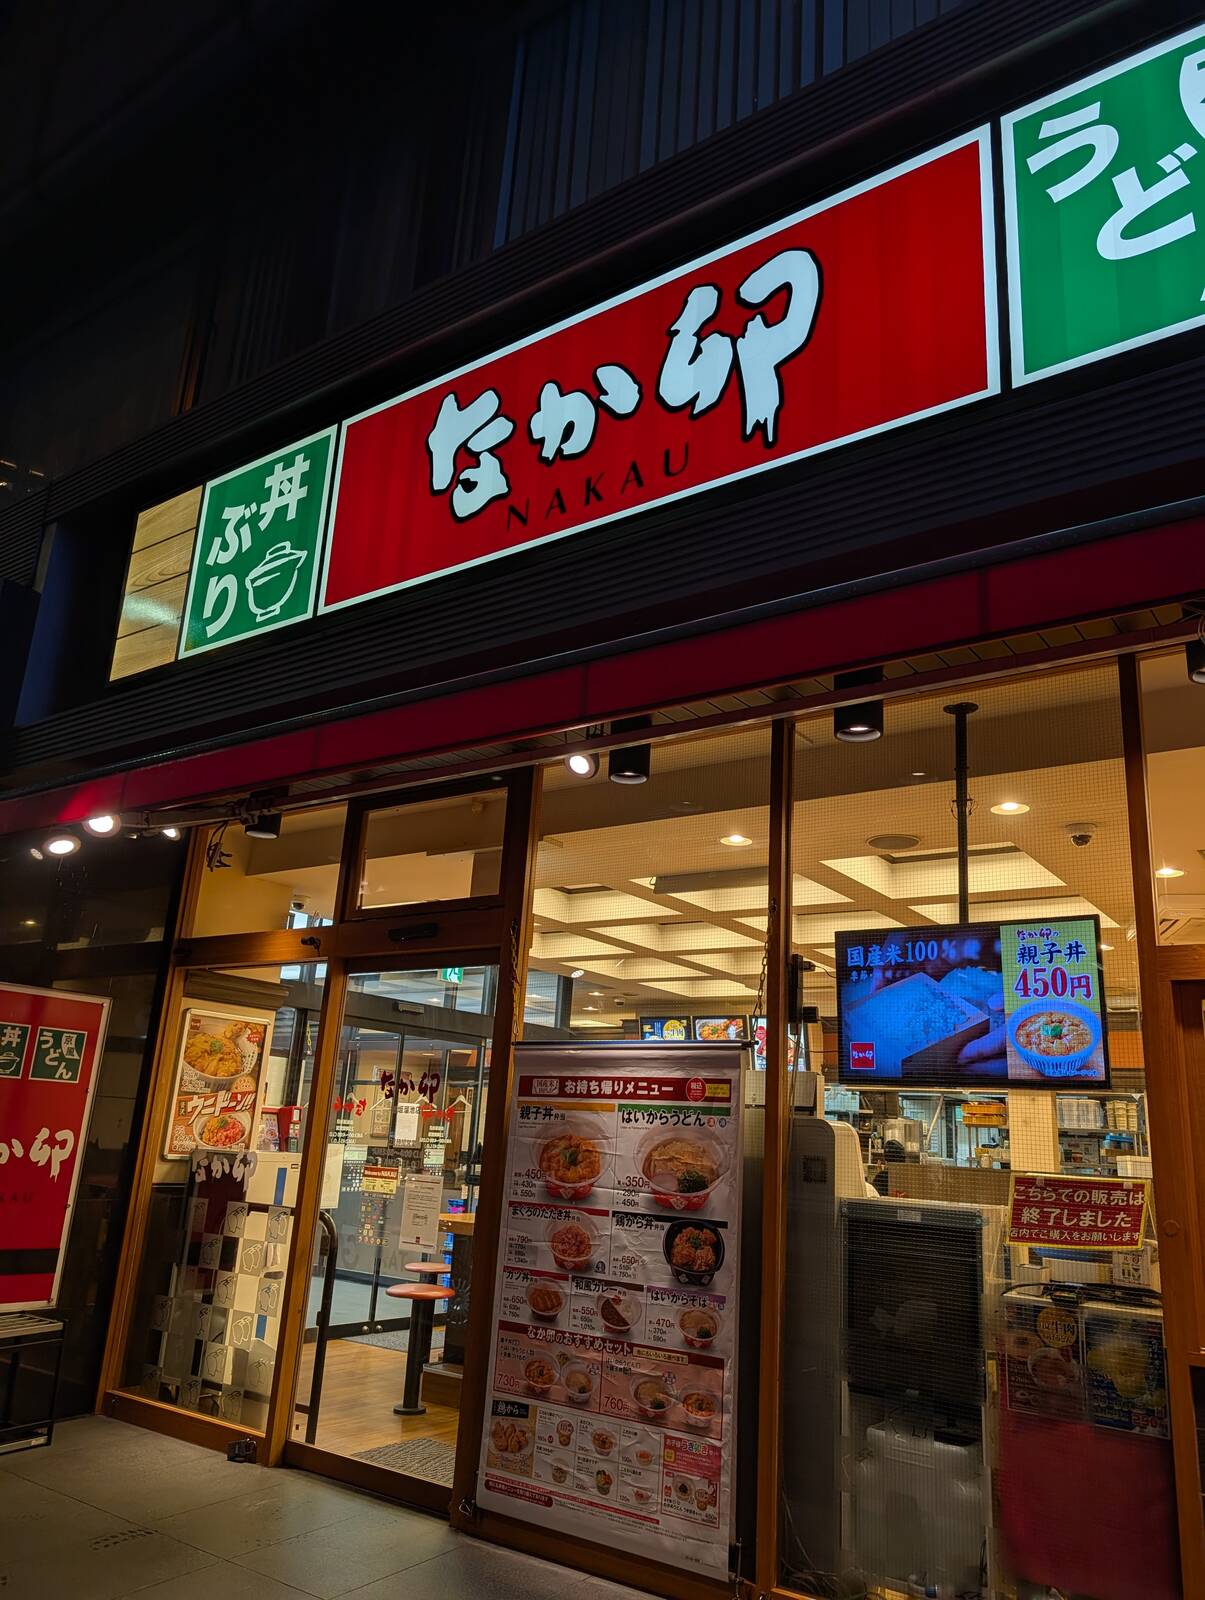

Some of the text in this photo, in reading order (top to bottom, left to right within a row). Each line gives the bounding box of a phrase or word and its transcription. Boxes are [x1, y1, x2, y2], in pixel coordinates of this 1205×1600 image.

[1026, 101, 1205, 301] うど
[426, 248, 824, 524] なか卯
[506, 442, 690, 531] NAKAU
[1017, 941, 1087, 965] 親子丼
[1015, 966, 1093, 999] 450円
[39, 1031, 72, 1079] うどん
[381, 1070, 441, 1103] なか卯
[564, 1079, 674, 1096] お持ち帰りメニュー
[622, 1108, 705, 1127] はいからうどん
[625, 1176, 650, 1189] 350円
[1014, 1185, 1145, 1206] こちらでの販売は
[1021, 1206, 1132, 1227] 終了しました
[650, 1290, 708, 1308] はいからそば
[527, 1325, 632, 1356] なか卯のおすすめセット
